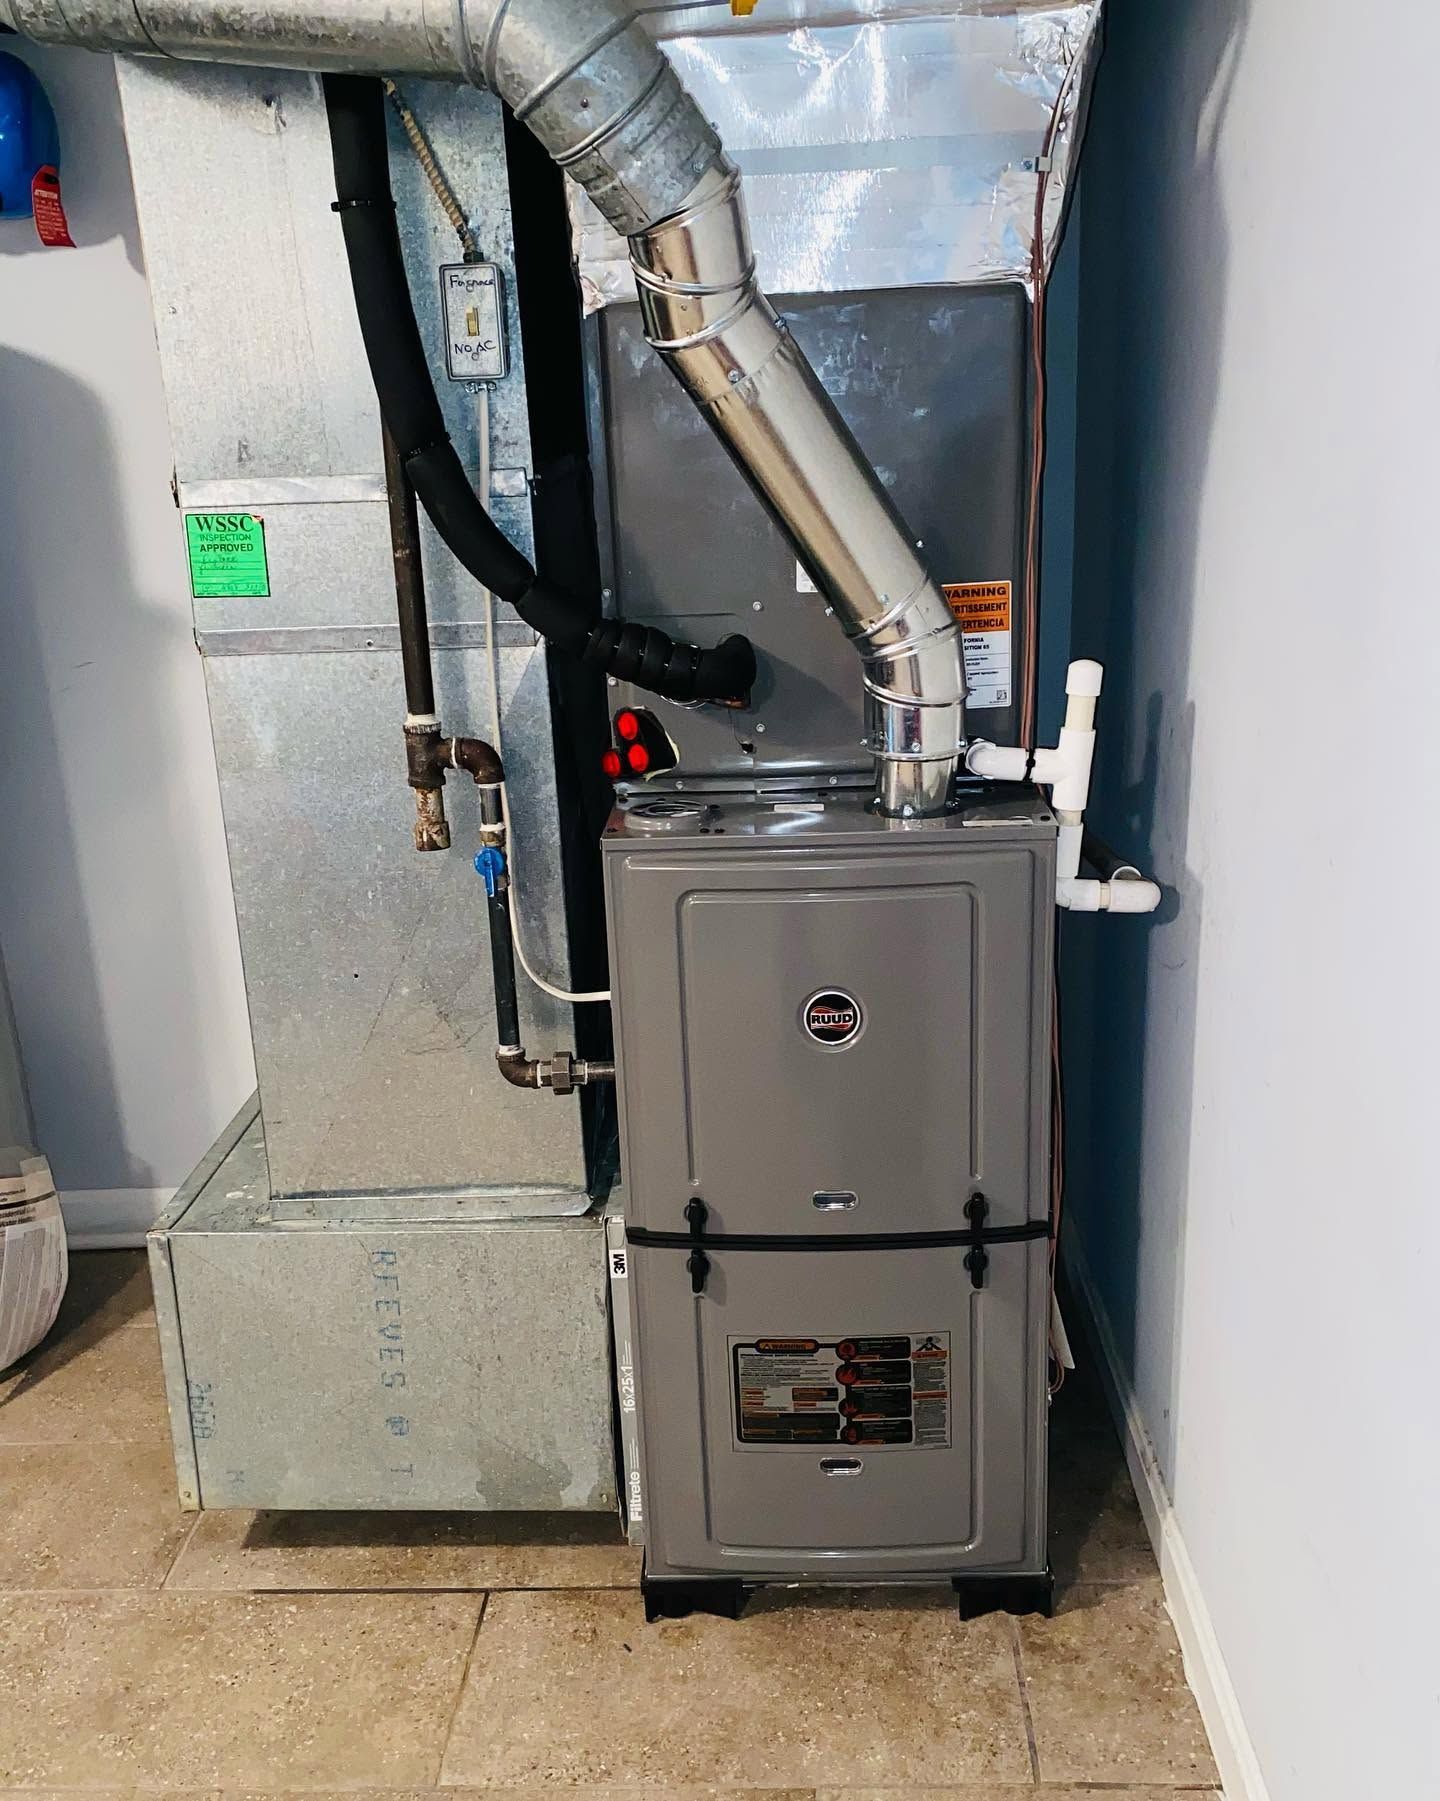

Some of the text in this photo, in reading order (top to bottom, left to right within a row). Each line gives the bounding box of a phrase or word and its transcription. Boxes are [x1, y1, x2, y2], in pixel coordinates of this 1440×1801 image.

[476, 340, 497, 352] AC
[195, 515, 254, 533] WSSC
[200, 533, 252, 542] INSPECTION
[199, 543, 254, 553] APPROVED
[811, 1012, 853, 1025] RUUD
[613, 1253, 626, 1275] 3M
[620, 1365, 637, 1414] 16x25x1
[629, 1471, 644, 1522] Filtrete
